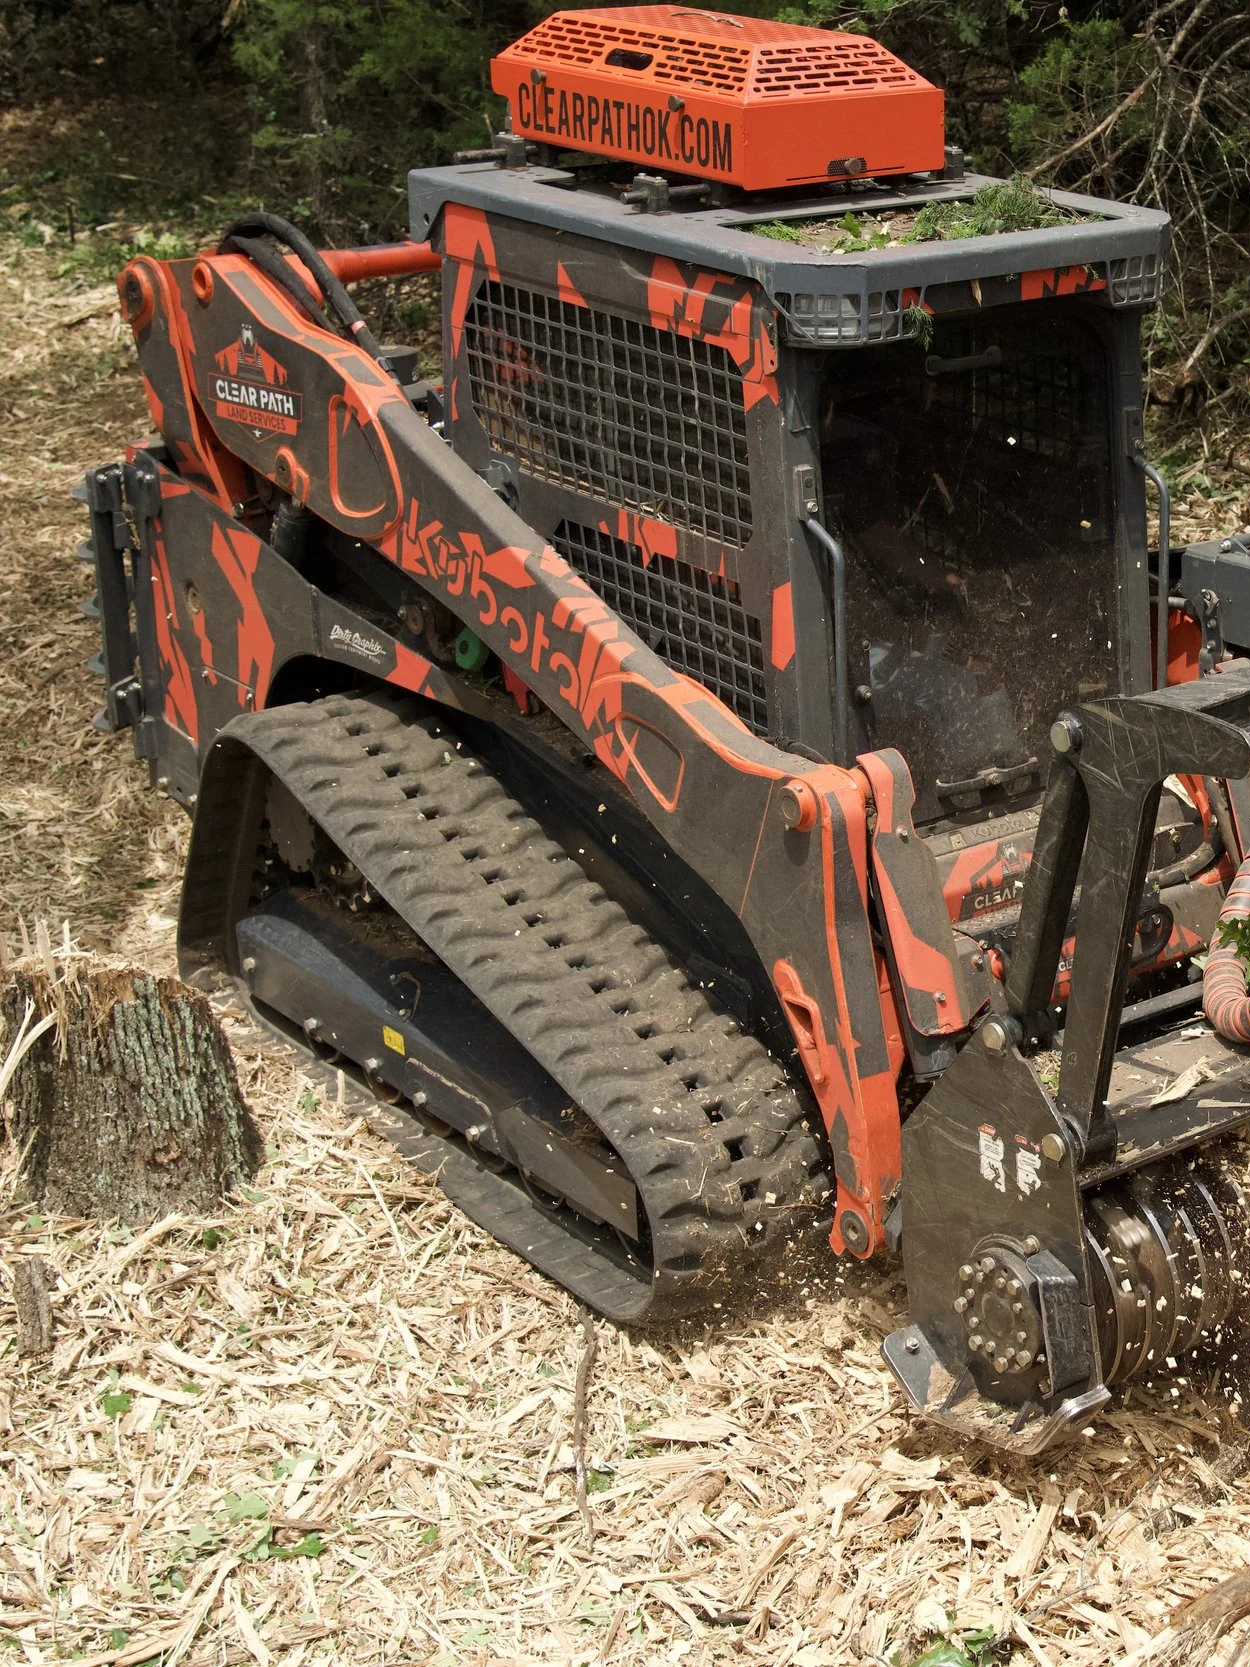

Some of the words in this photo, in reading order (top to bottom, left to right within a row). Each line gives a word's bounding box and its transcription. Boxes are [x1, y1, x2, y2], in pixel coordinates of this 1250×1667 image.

[518, 82, 733, 173] CLEARPATHOK.COM
[216, 379, 258, 407] CLEAR
[260, 389, 294, 416] PATH
[227, 404, 248, 421] LAND
[249, 410, 286, 430] SERVICES
[330, 624, 353, 643] Dirty
[970, 820, 1024, 838] Kubota
